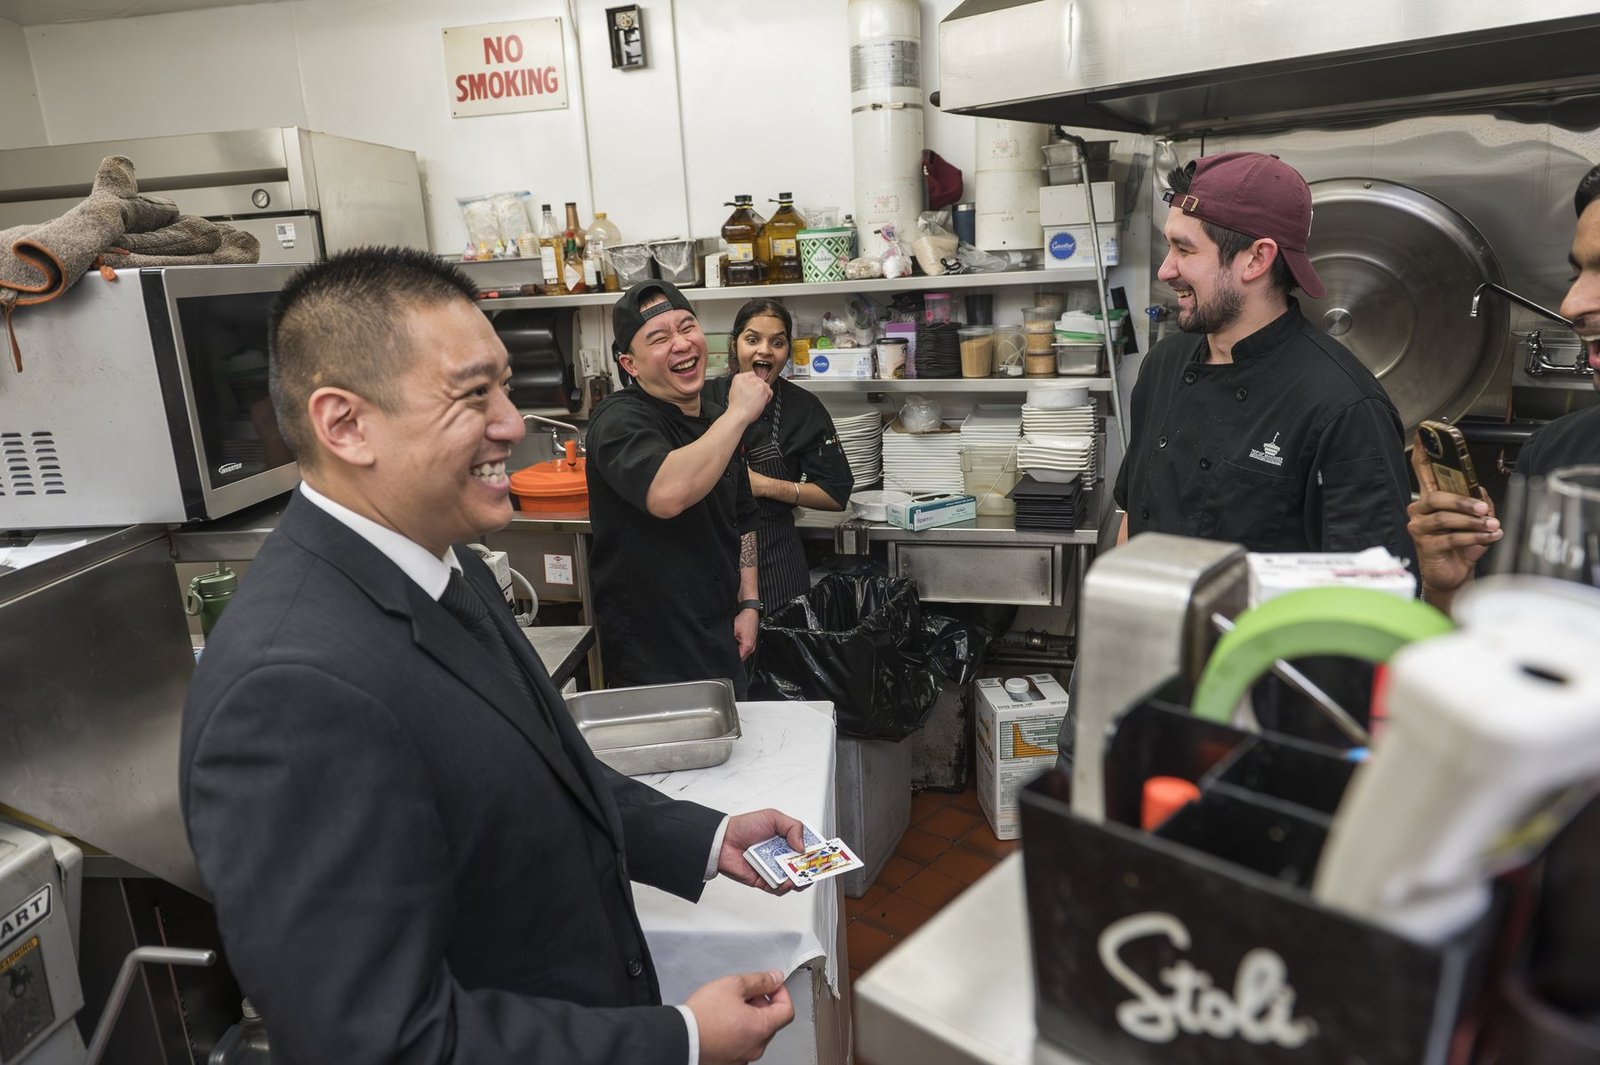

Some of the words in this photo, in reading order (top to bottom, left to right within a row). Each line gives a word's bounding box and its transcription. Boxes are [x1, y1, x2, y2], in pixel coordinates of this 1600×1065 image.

[483, 34, 524, 65] NO
[455, 66, 559, 103] SMOKING
[1096, 910, 1321, 1050] Stoli
